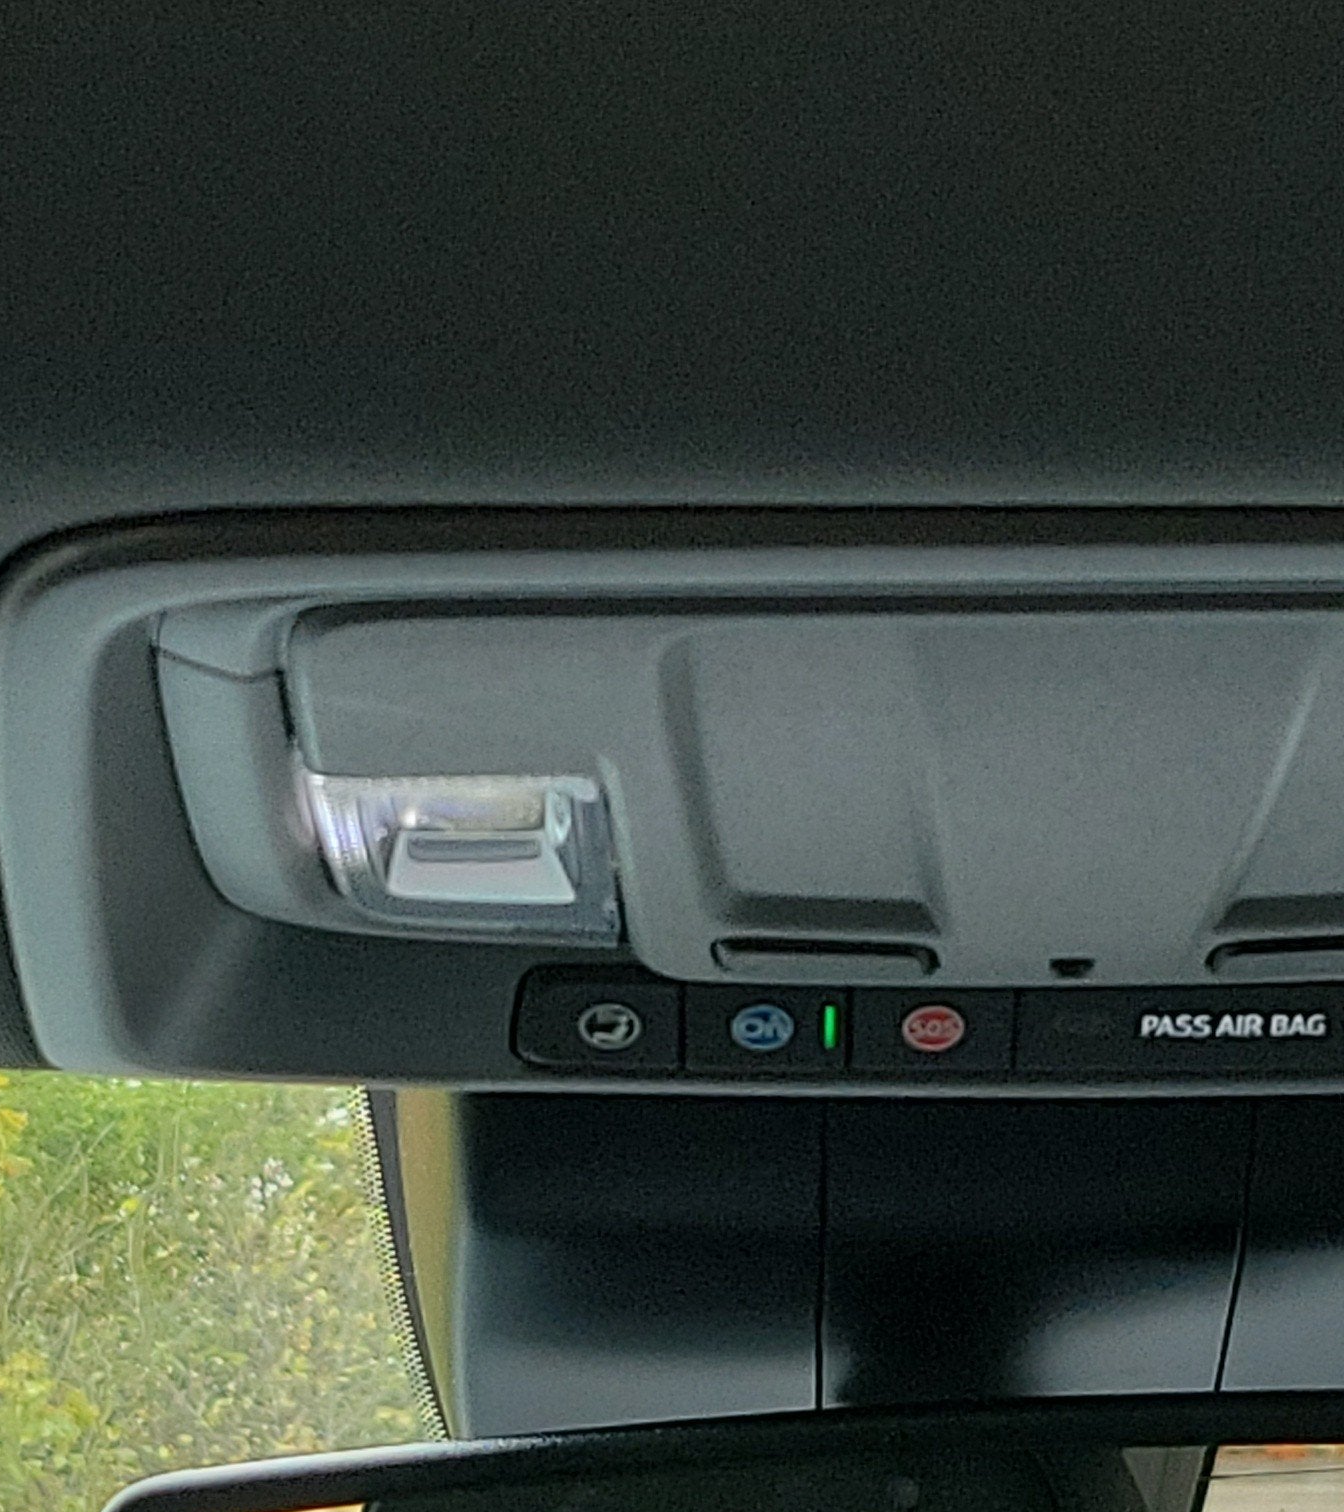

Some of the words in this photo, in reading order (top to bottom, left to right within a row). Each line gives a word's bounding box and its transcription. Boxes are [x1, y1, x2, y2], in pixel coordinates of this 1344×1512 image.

[907, 1018, 960, 1038] SOS
[1140, 1014, 1211, 1038] PASS
[1215, 1014, 1263, 1037] AIR
[1270, 1014, 1326, 1037] BAG
